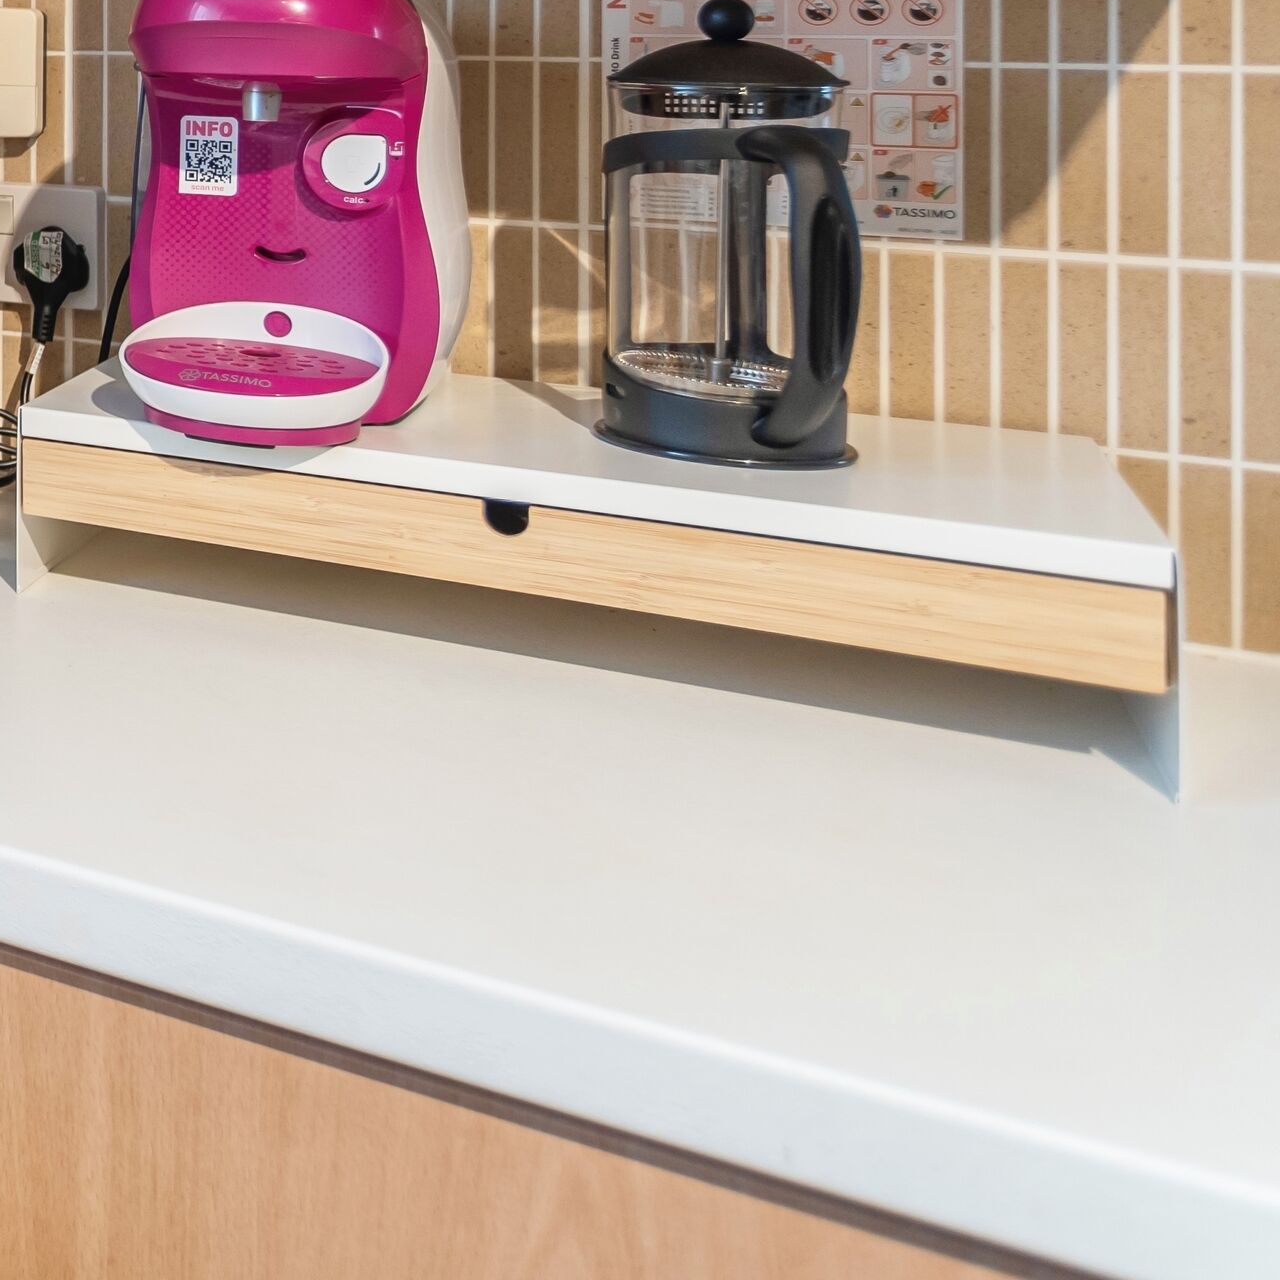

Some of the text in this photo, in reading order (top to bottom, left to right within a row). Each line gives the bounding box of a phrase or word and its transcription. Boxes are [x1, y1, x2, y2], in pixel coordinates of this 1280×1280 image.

[610, 37, 621, 61] Drink
[185, 120, 233, 138] INFO
[892, 207, 956, 219] TASSIMO
[201, 371, 272, 388] TASSIMO
